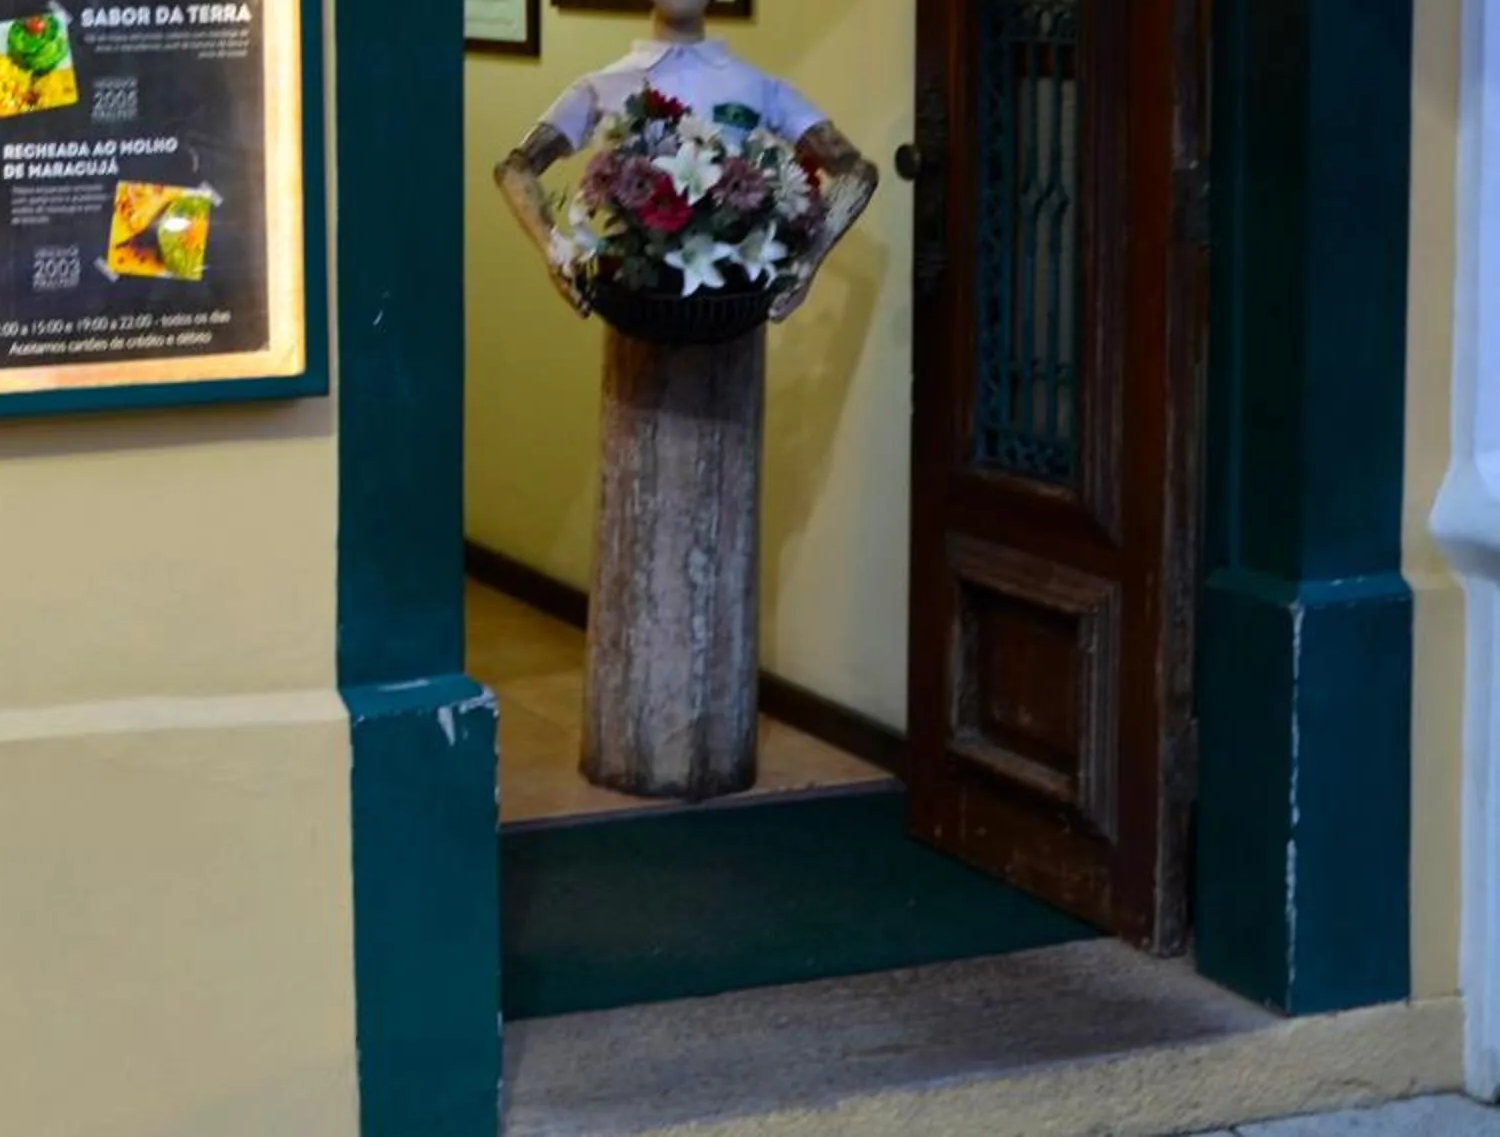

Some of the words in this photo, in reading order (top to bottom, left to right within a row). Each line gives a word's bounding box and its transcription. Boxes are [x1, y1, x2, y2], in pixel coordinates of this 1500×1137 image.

[81, 6, 151, 27] SABOR
[155, 4, 184, 24] DA
[186, 2, 252, 23] TERRA
[3, 141, 90, 160] RECHEADA
[92, 139, 117, 158] AO
[119, 136, 178, 156] MOLHO
[3, 163, 25, 180] DE
[28, 158, 119, 178] MARACUJÁ
